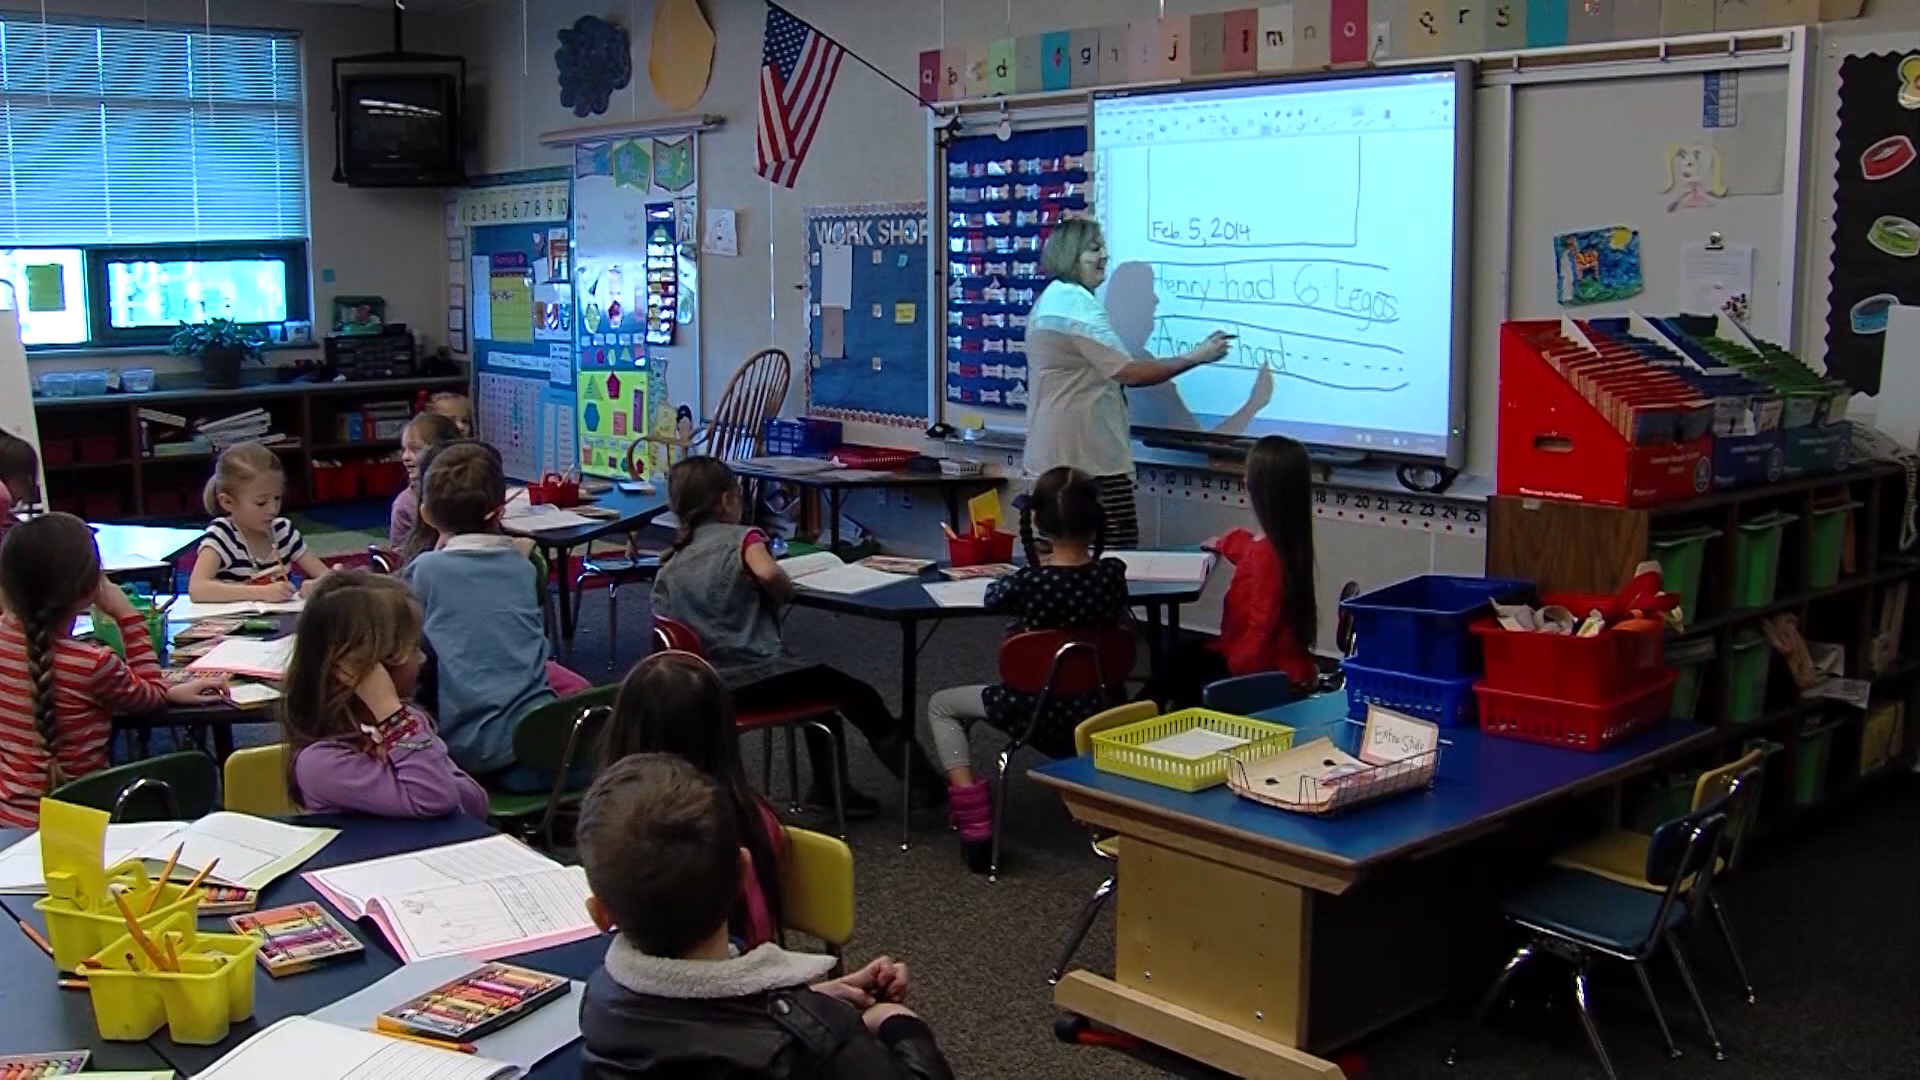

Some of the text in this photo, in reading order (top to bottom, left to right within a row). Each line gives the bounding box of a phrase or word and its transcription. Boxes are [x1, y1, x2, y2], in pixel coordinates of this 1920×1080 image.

[922, 69, 933, 85] a
[947, 66, 958, 86] b
[996, 57, 1008, 78] d
[1080, 47, 1091, 65] g
[1168, 34, 1179, 61] j
[1266, 30, 1285, 47] m
[1304, 25, 1317, 40] n
[1343, 21, 1357, 38] o
[1459, 8, 1471, 24] r
[1496, 5, 1511, 27] s
[471, 205, 478, 222] 2
[501, 202, 508, 219] 5
[512, 201, 519, 218] 6
[523, 200, 530, 217] 7
[535, 199, 541, 216] 8
[547, 199, 554, 215] 9
[1211, 217, 1250, 241] 2014
[814, 219, 873, 246] WORK
[1223, 263, 1275, 301] had
[1293, 263, 1319, 306] 6
[1236, 324, 1287, 371] had
[1165, 471, 1177, 485] 10
[1183, 473, 1192, 486] 11
[1201, 475, 1212, 488] 12
[1220, 478, 1230, 490] 13
[1315, 488, 1327, 503] 18
[1336, 492, 1348, 505] 19
[1354, 495, 1370, 509] 20
[1377, 496, 1389, 511] 21
[1397, 500, 1413, 514] 22
[1419, 503, 1436, 517] 23
[1442, 505, 1458, 520] 24
[1464, 507, 1480, 522] 25
